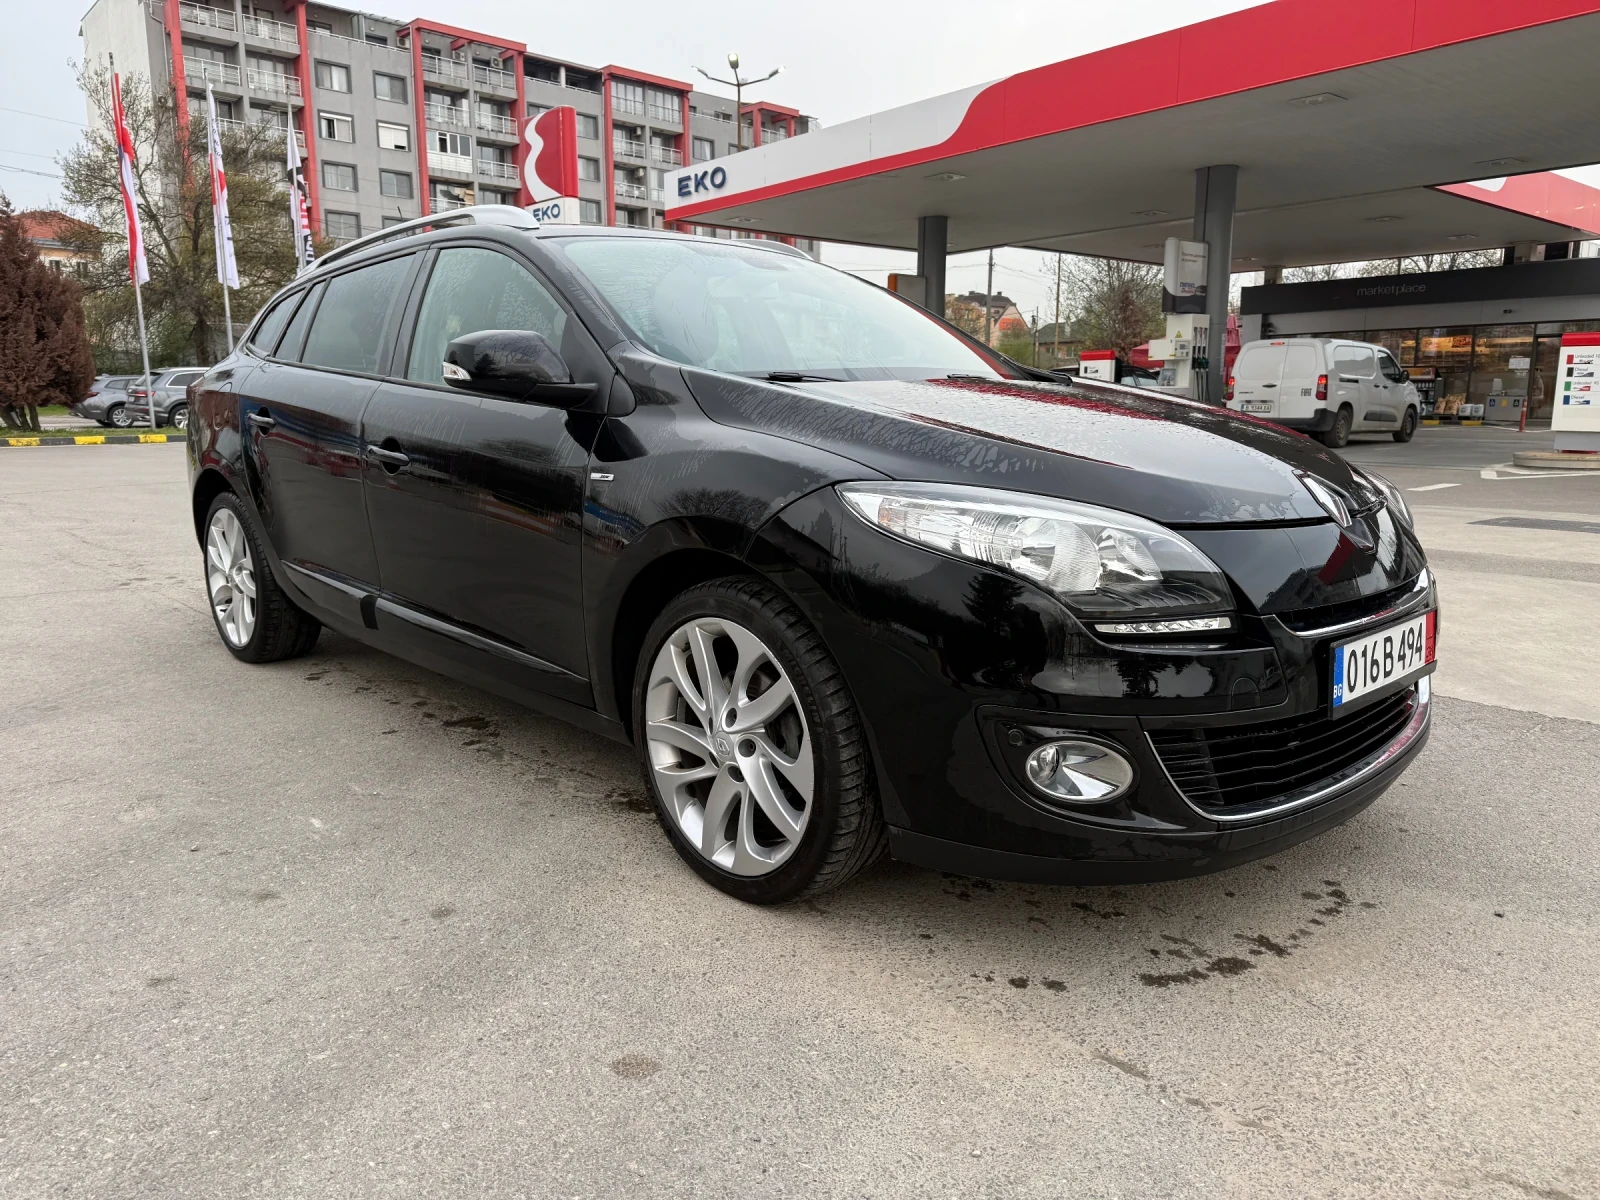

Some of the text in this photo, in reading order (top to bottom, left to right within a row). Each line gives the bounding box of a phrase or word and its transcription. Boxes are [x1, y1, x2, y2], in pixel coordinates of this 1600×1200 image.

[677, 166, 727, 197] EKO
[533, 203, 561, 222] EKO
[1301, 388, 1312, 396] FIAT
[1333, 684, 1343, 698] BG
